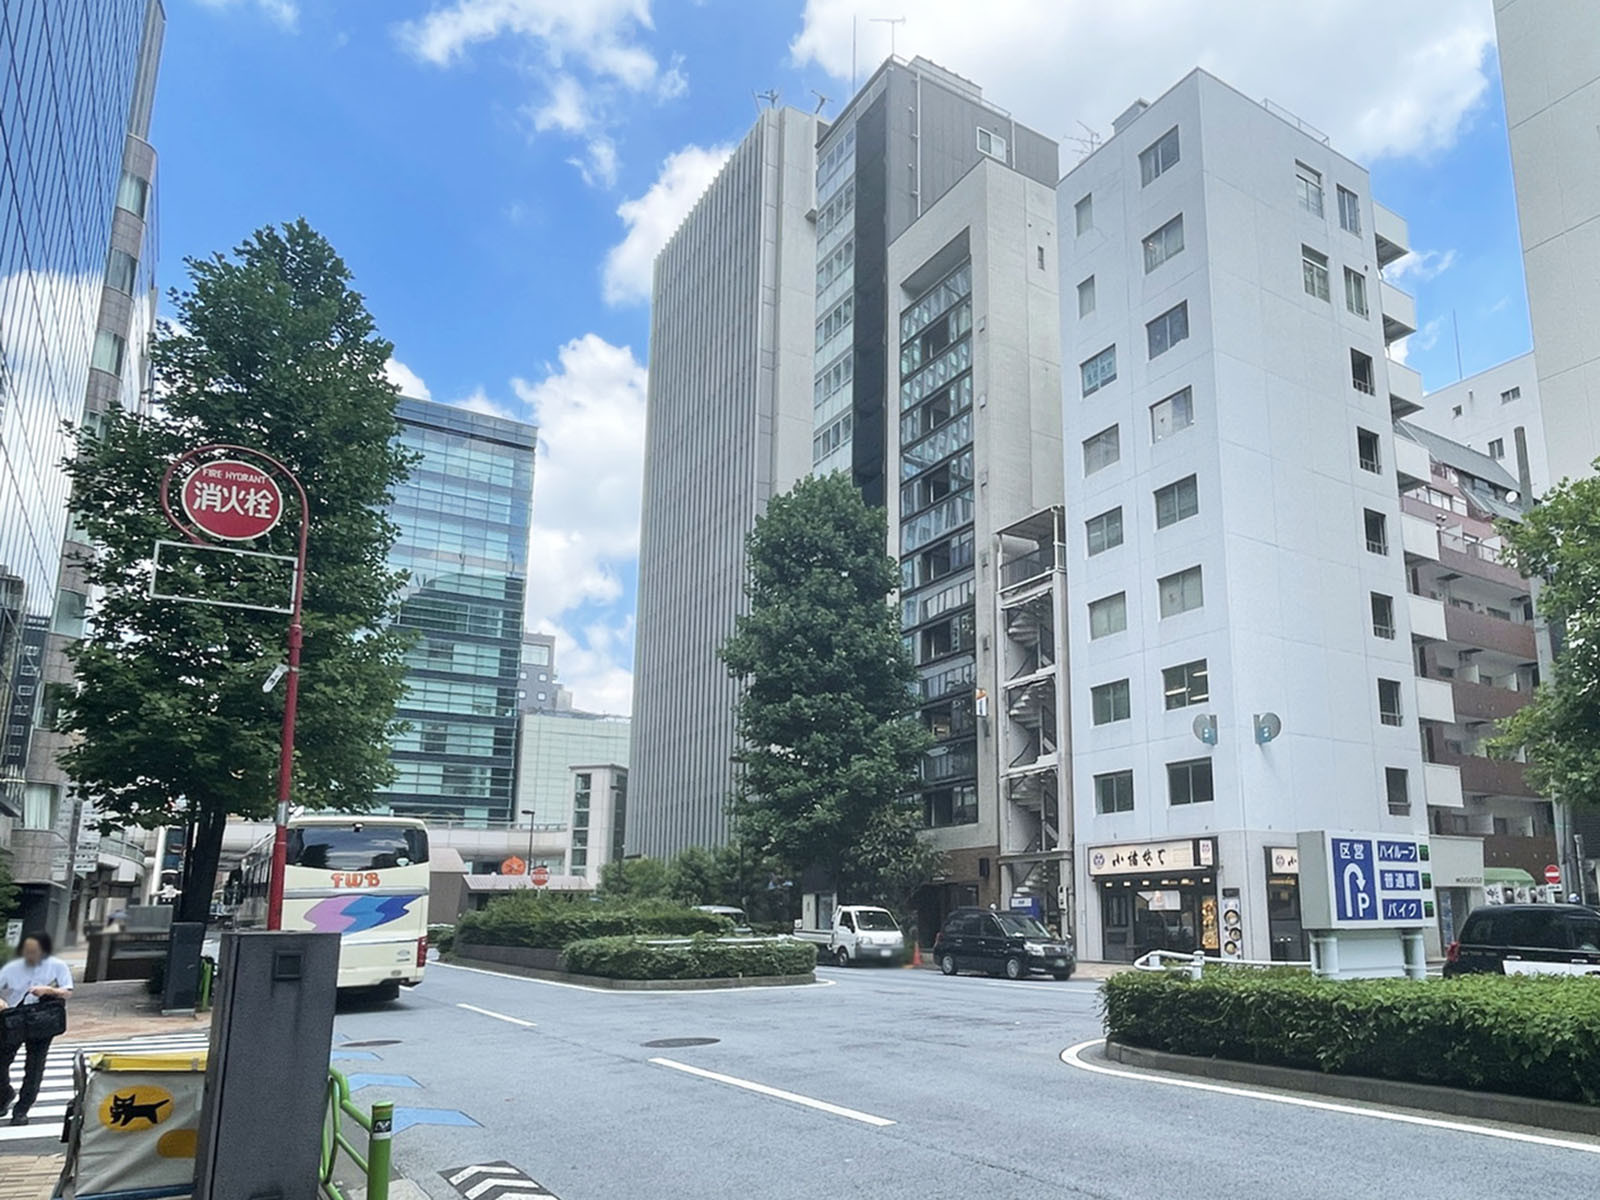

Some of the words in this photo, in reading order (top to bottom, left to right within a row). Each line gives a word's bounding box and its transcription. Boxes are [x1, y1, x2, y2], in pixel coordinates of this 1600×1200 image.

[203, 469, 223, 479] FIRE
[225, 471, 267, 484] HYDRANT
[193, 481, 274, 519] 消火栓
[1380, 844, 1416, 860] ハイルーフ
[1384, 872, 1416, 889] 普通車
[1358, 892, 1370, 918] P
[1388, 903, 1417, 918] バイク
